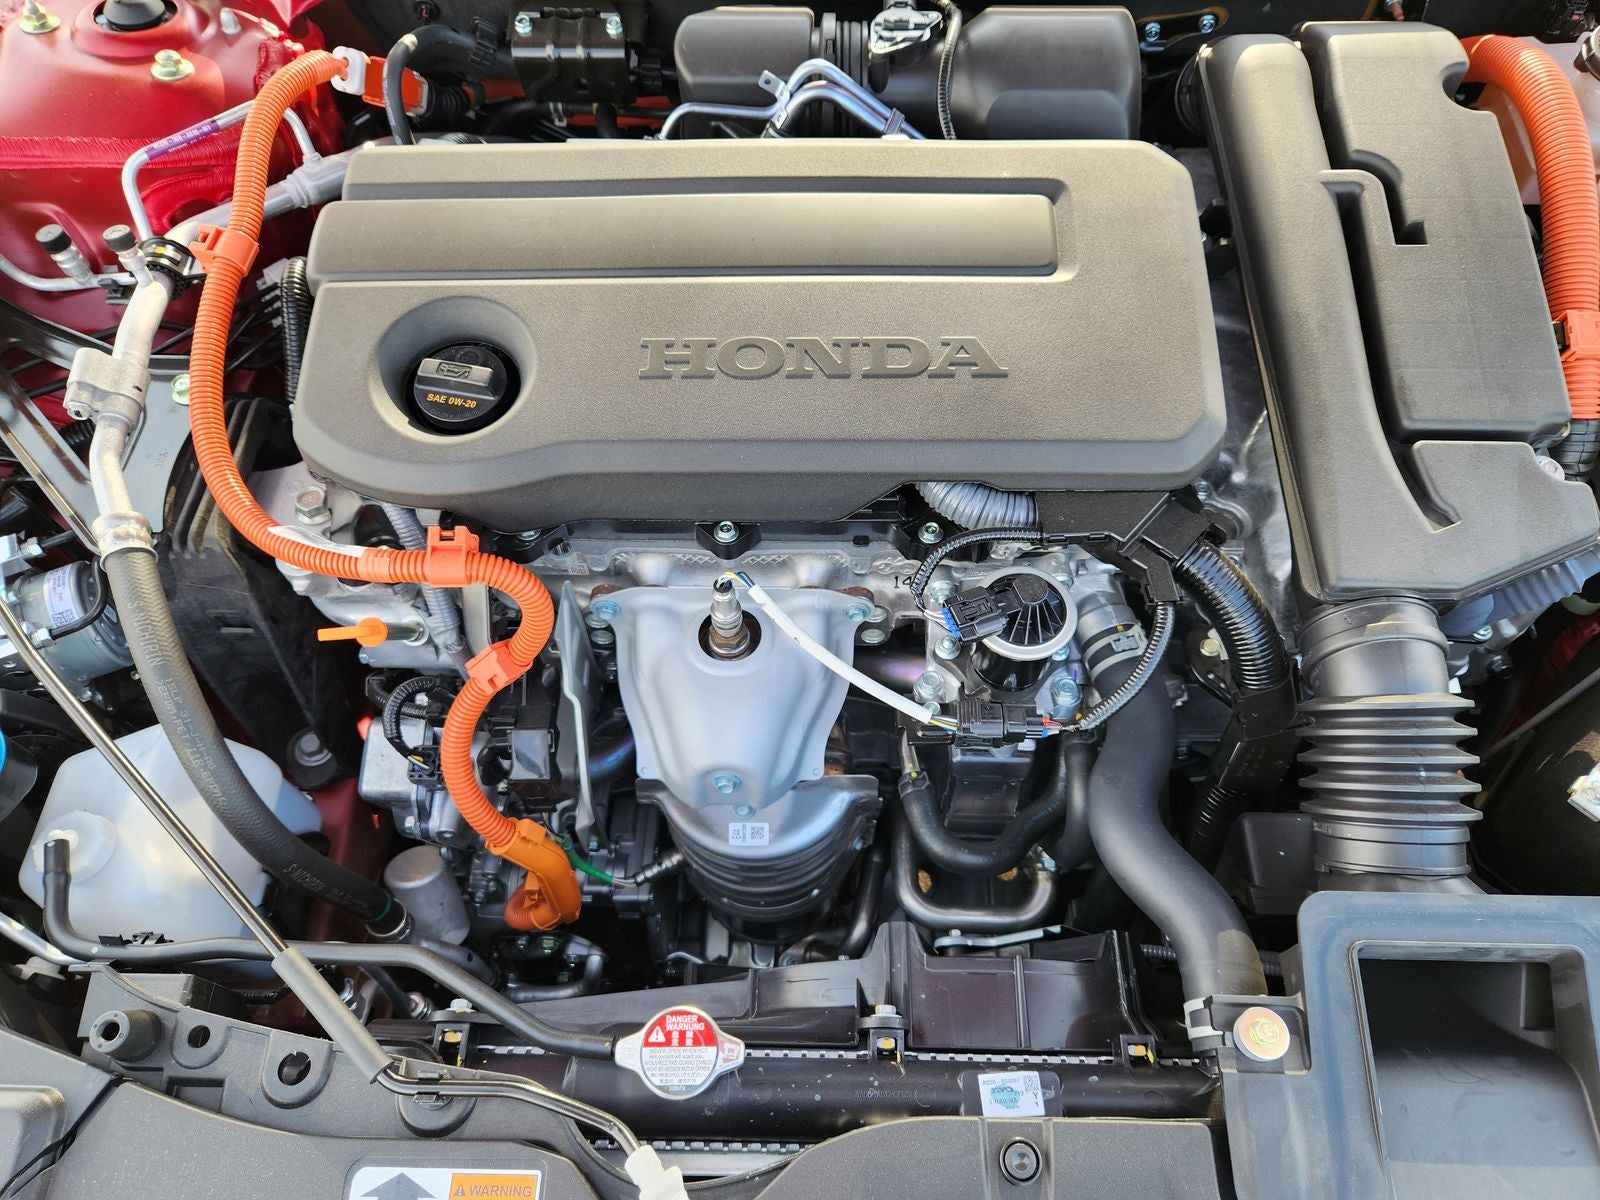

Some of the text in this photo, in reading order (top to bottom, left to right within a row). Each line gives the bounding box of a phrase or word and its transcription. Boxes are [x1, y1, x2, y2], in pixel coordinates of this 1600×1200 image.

[639, 336, 1009, 379] HONDA
[427, 393, 477, 408] SAE 0W-20
[665, 1015, 698, 1023] DANGER
[665, 1022, 705, 1031] WARNUNG
[469, 1185, 532, 1197] WARNING
